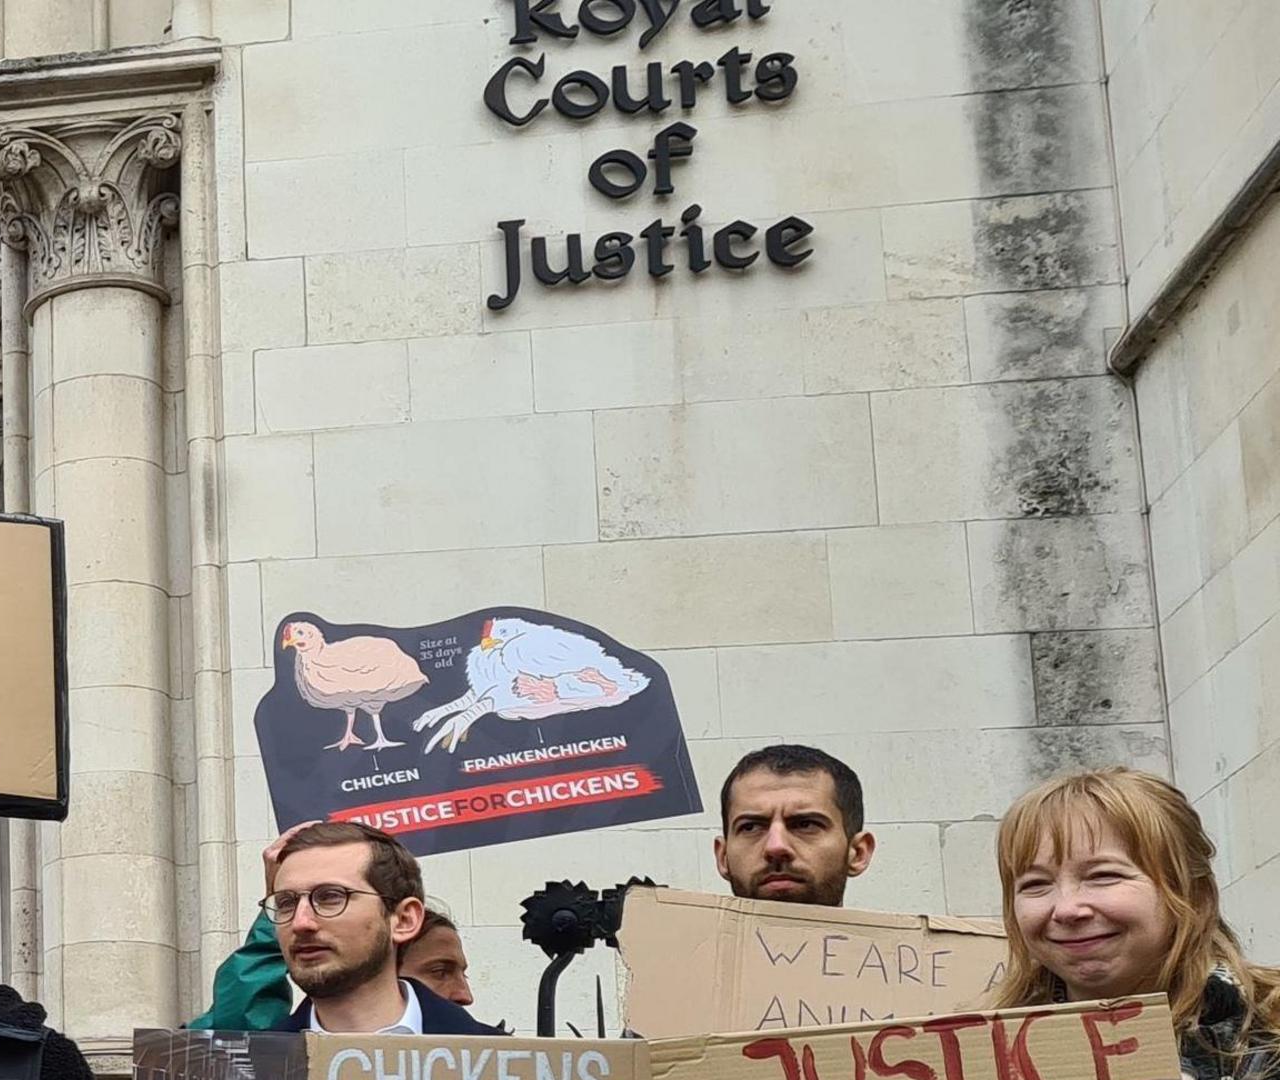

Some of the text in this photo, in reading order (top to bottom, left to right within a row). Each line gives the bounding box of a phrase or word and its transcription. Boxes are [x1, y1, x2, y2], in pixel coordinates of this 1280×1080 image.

[483, 46, 799, 126] Courts
[588, 121, 698, 200] of
[486, 203, 814, 312] Justice
[419, 646, 462, 660] 35 days
[420, 636, 457, 650] Size at
[435, 657, 453, 669] old
[463, 735, 627, 771] FRANKENCHICKEN
[340, 768, 420, 793] CHICKEN
